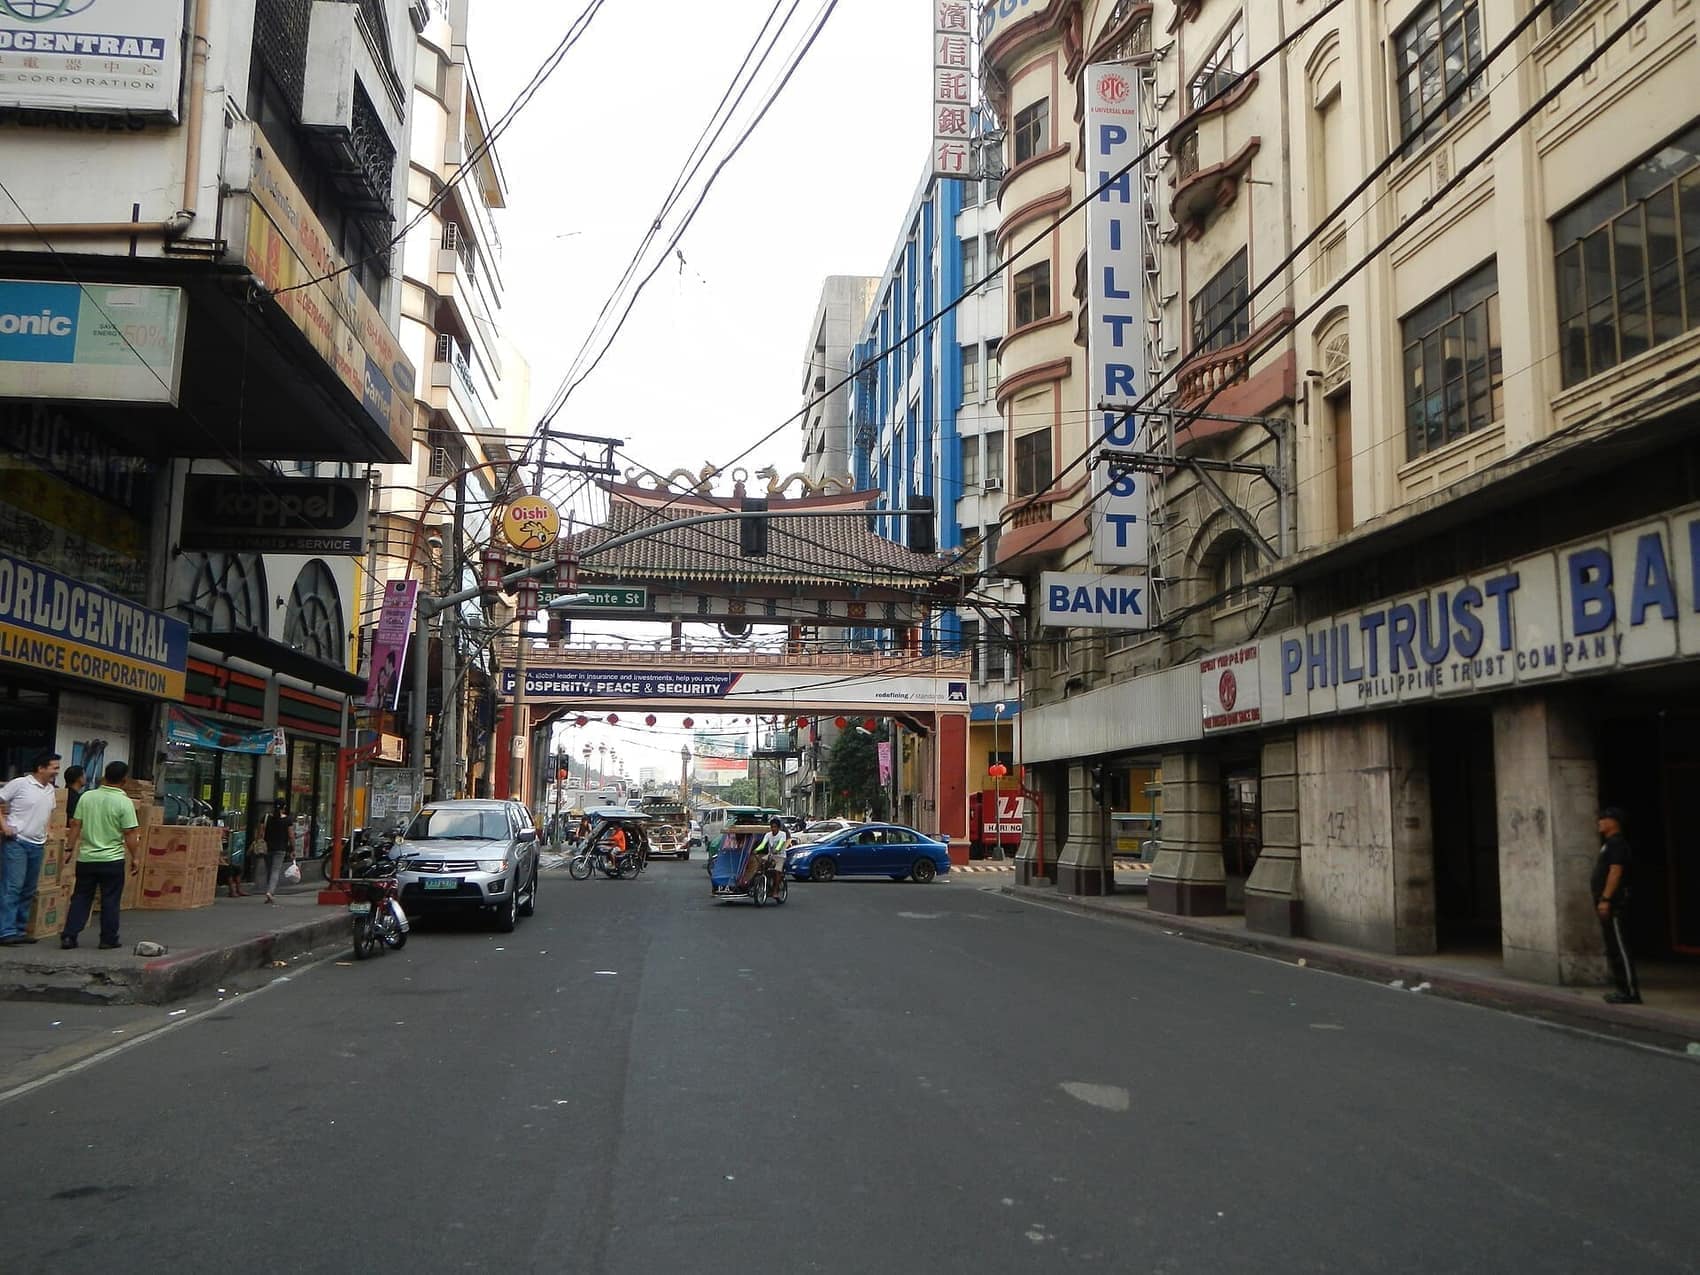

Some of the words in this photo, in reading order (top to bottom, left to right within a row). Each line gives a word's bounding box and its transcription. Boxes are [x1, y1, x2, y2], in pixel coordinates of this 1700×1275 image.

[17, 74, 155, 89] CORPORATION
[1099, 124, 1137, 547] PHILTRUST
[511, 506, 549, 521] Oishi
[297, 539, 351, 551] SERVICE
[624, 594, 640, 604] St
[1049, 584, 1143, 616] BANK
[1281, 571, 1520, 697] PHILTRUST
[1567, 519, 1700, 637] BA
[70, 650, 166, 694] CORPORATION
[1357, 664, 1444, 700] PHILIPPINE
[1450, 653, 1506, 684] TRUST
[1516, 632, 1625, 672] COMPANY
[507, 680, 593, 695] POSPERITY,
[597, 682, 640, 693] PEACE
[644, 682, 653, 693] &
[657, 683, 720, 694] SECURITY
